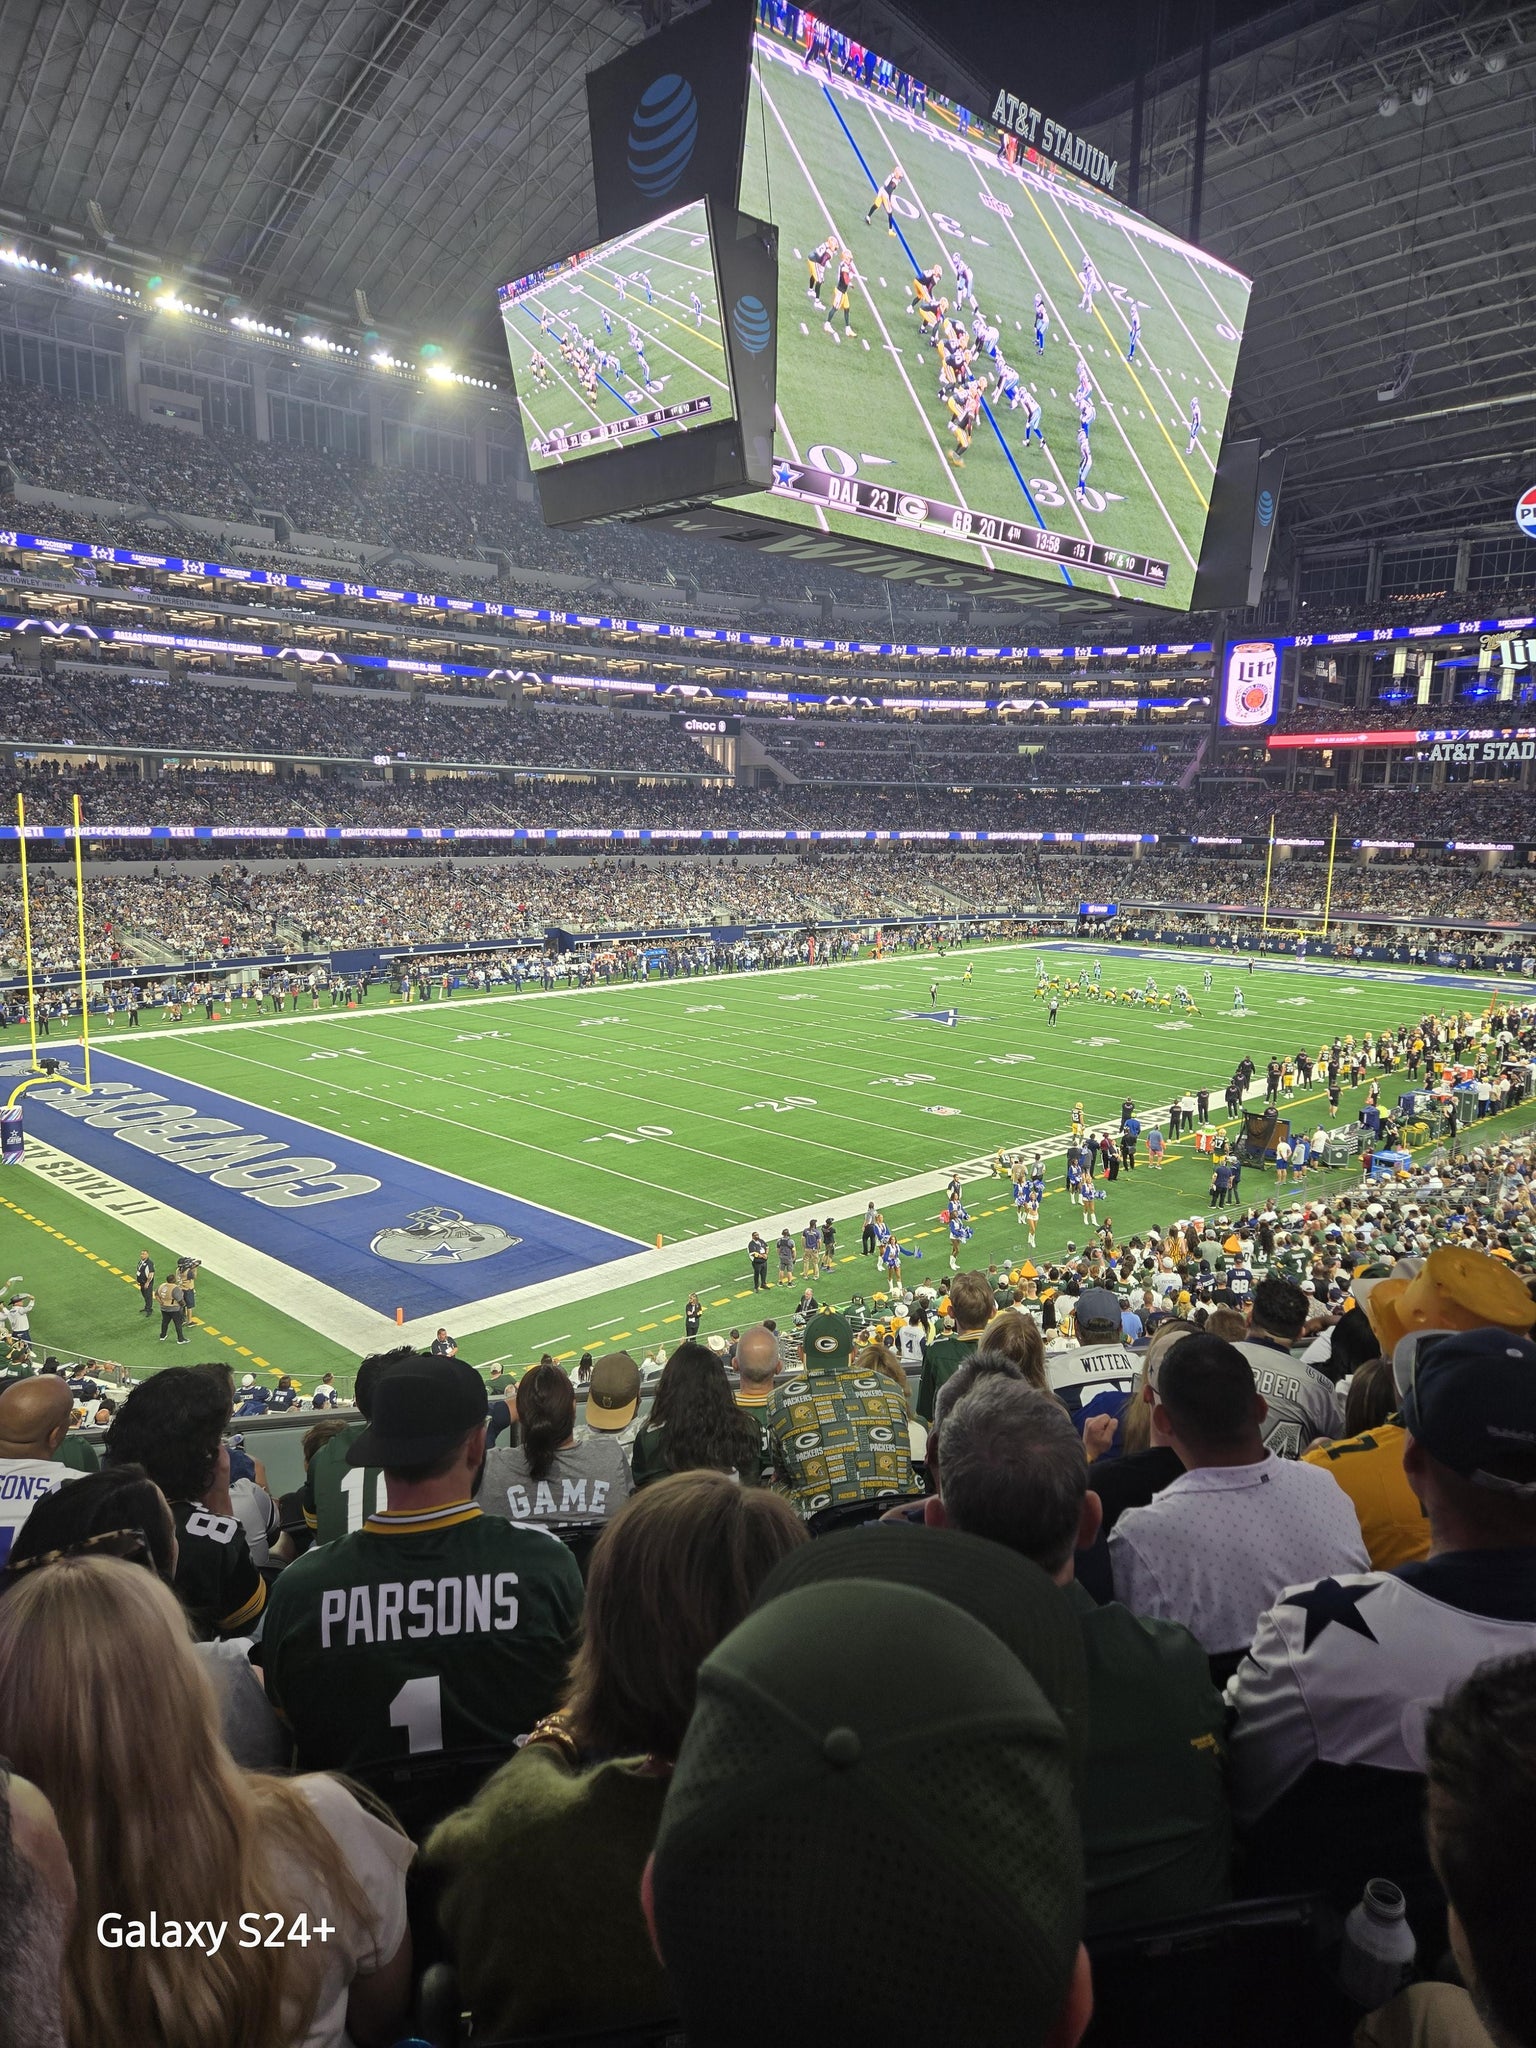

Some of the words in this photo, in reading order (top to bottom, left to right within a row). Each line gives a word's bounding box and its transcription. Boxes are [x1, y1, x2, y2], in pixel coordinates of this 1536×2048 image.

[992, 89, 1042, 143] AT&T
[1042, 118, 1118, 191] STADIUM
[828, 477, 860, 506] DAL
[870, 489, 890, 512] 23
[952, 511, 972, 533] GB
[979, 518, 995, 539] 20
[1036, 532, 1060, 553] 13:58
[1125, 557, 1136, 570] 10
[10, 575, 40, 586] HOWLEY
[758, 534, 1113, 613] WINSTAR
[1238, 661, 1274, 683] Lite
[1428, 743, 1480, 761] AT&T
[14, 826, 45, 838] YETI
[169, 827, 195, 838] YETI
[303, 828, 326, 838] YETI
[422, 828, 441, 838] YETI
[880, 1072, 936, 1087] 30
[753, 1096, 818, 1113] 20
[601, 1125, 674, 1144] 10
[26, 1082, 382, 1208] COWBOYS
[36, 1161, 126, 1200] TAKES
[105, 1200, 161, 1216] IT
[1231, 1279, 1249, 1294] 88
[815, 1336, 838, 1353] G
[905, 1339, 914, 1353] 4
[1080, 1354, 1133, 1373] WITTEN
[783, 1394, 813, 1409] PACKERS
[855, 1389, 883, 1399] PACKERS
[796, 1446, 824, 1462] PACKERS
[870, 1443, 896, 1453] PACKERS
[0, 1475, 50, 1500] ONS
[507, 1479, 610, 1519] GAME
[321, 1572, 519, 1649] PARSONS
[389, 1675, 444, 1755] 1
